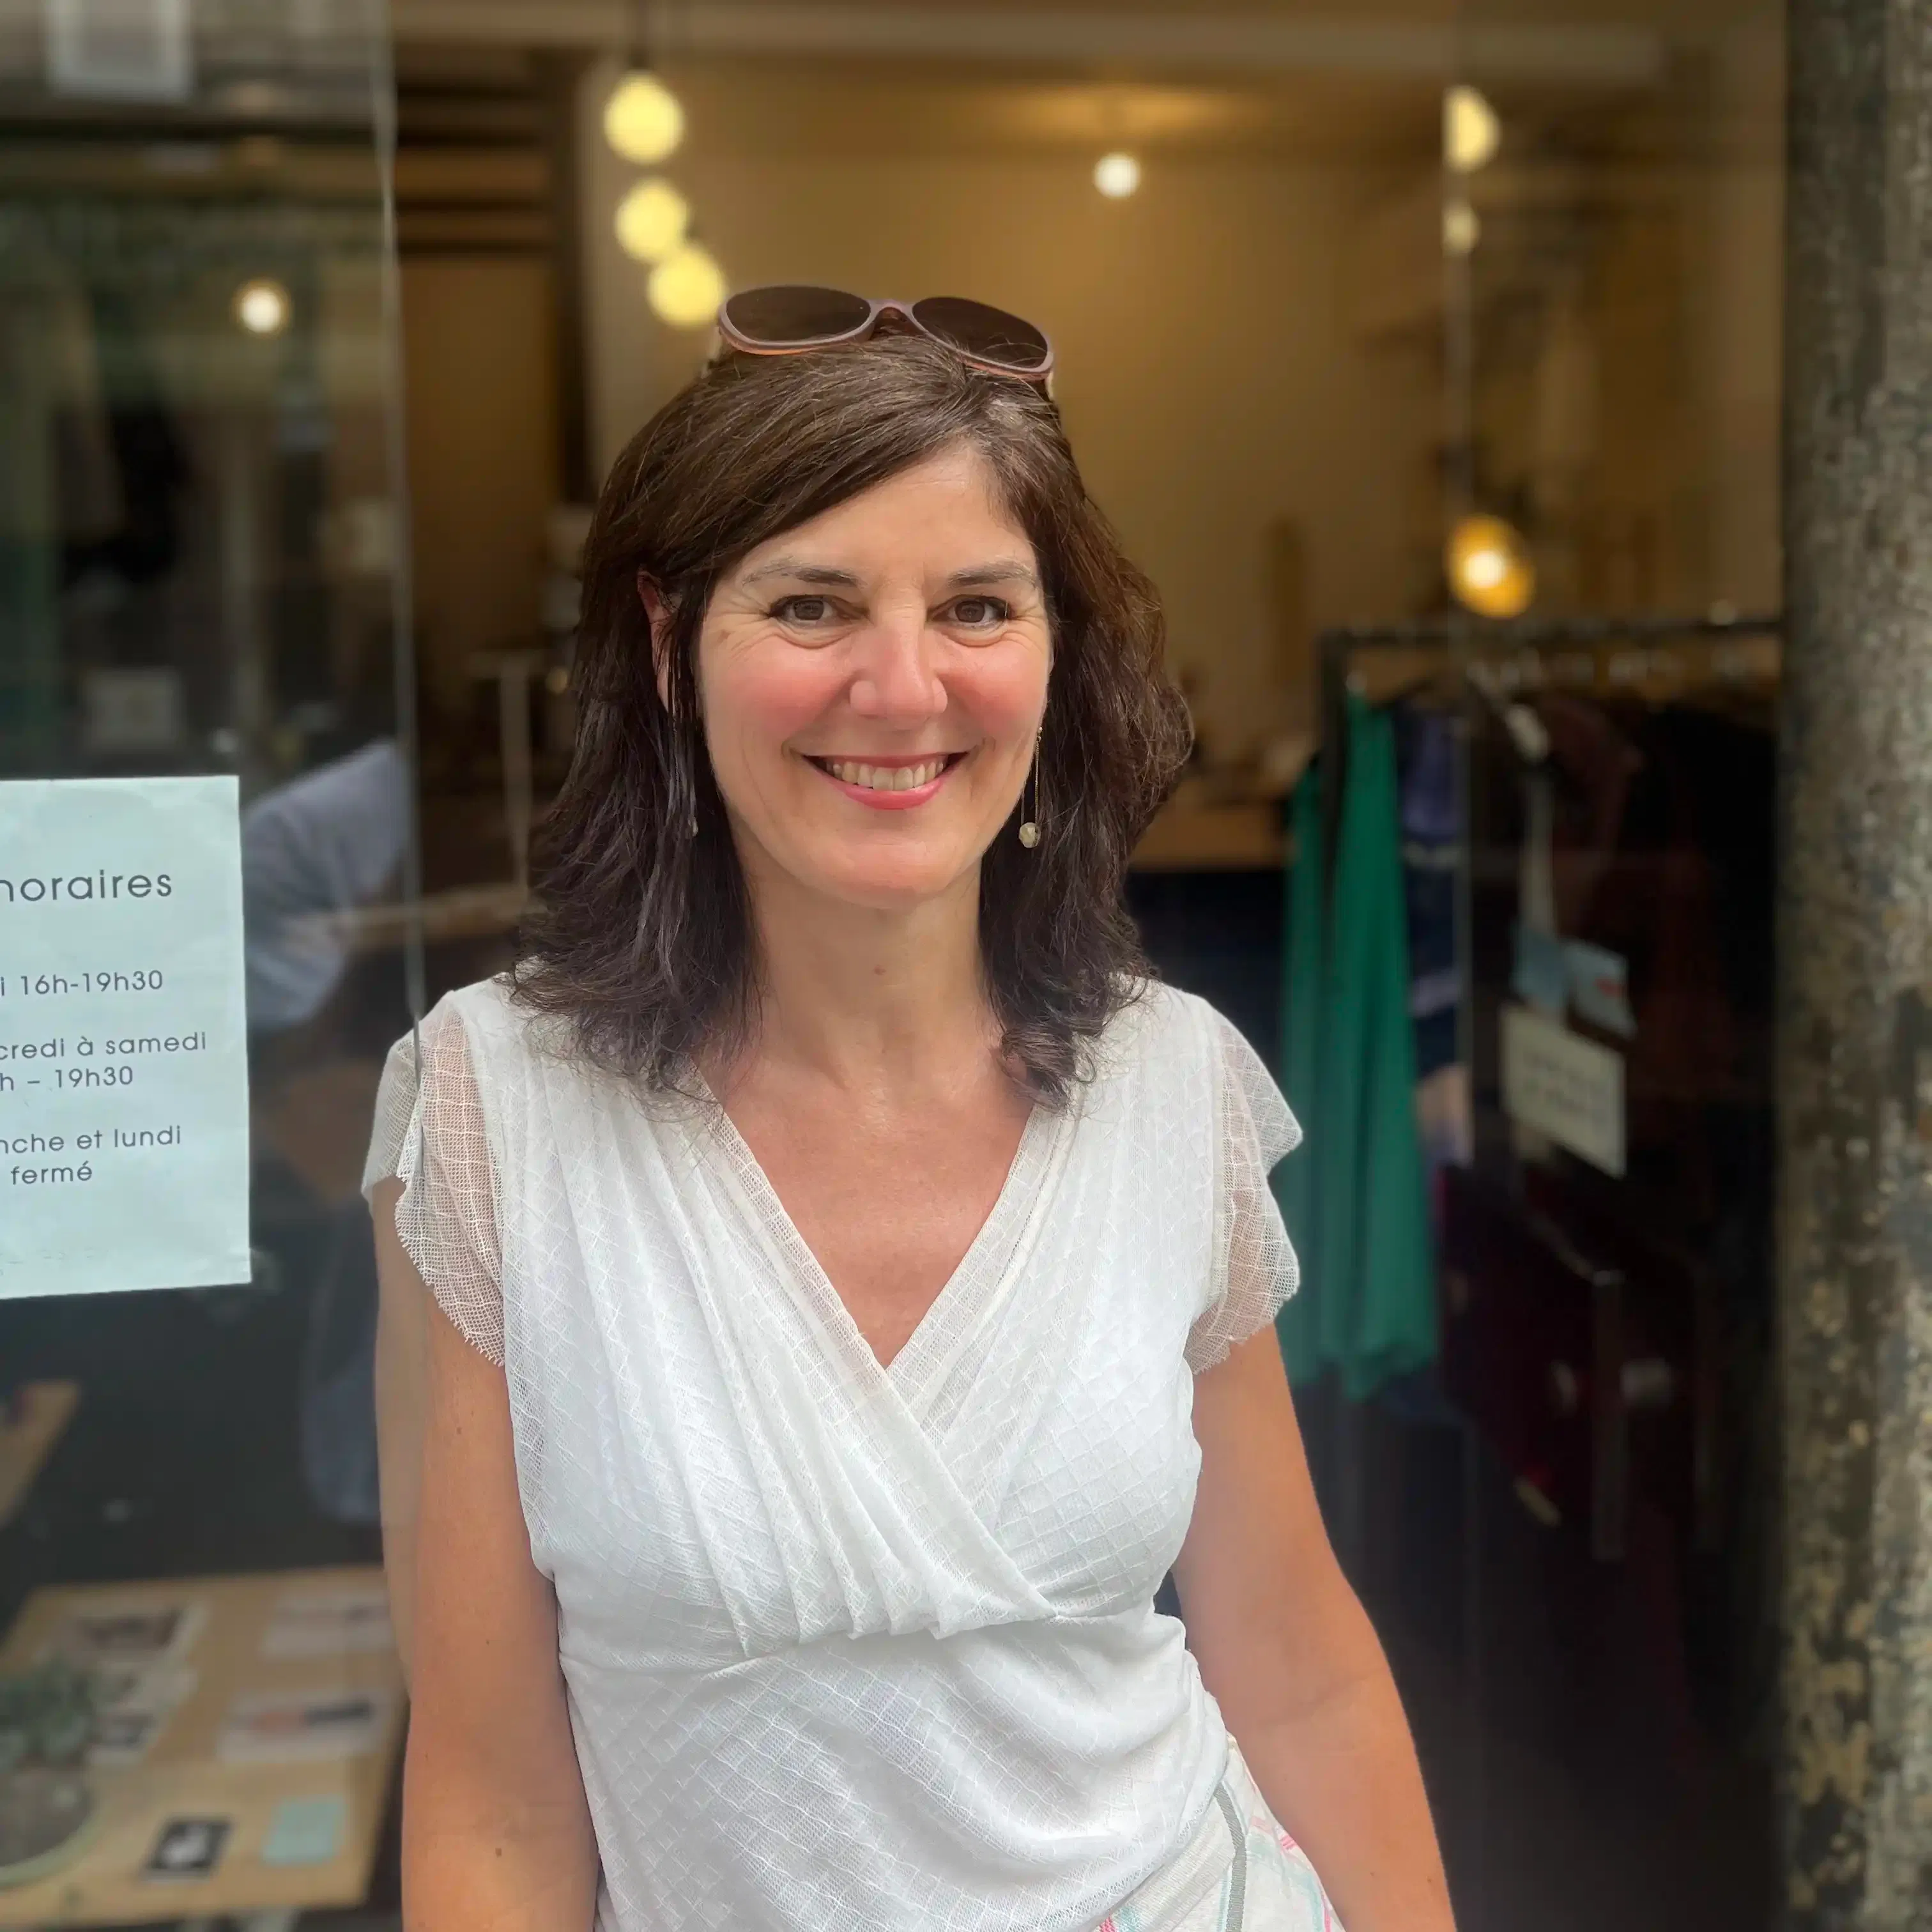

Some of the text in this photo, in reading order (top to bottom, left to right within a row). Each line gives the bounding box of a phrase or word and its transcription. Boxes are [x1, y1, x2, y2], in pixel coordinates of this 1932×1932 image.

[20, 970, 163, 995] 16h-19h30
[77, 1036, 94, 1057] à
[105, 1031, 206, 1055] samedi
[0, 1073, 14, 1092] h
[55, 1066, 134, 1089] 19h30
[76, 1130, 103, 1150] et
[114, 1124, 181, 1147] lundi
[10, 1160, 93, 1185] fermé
